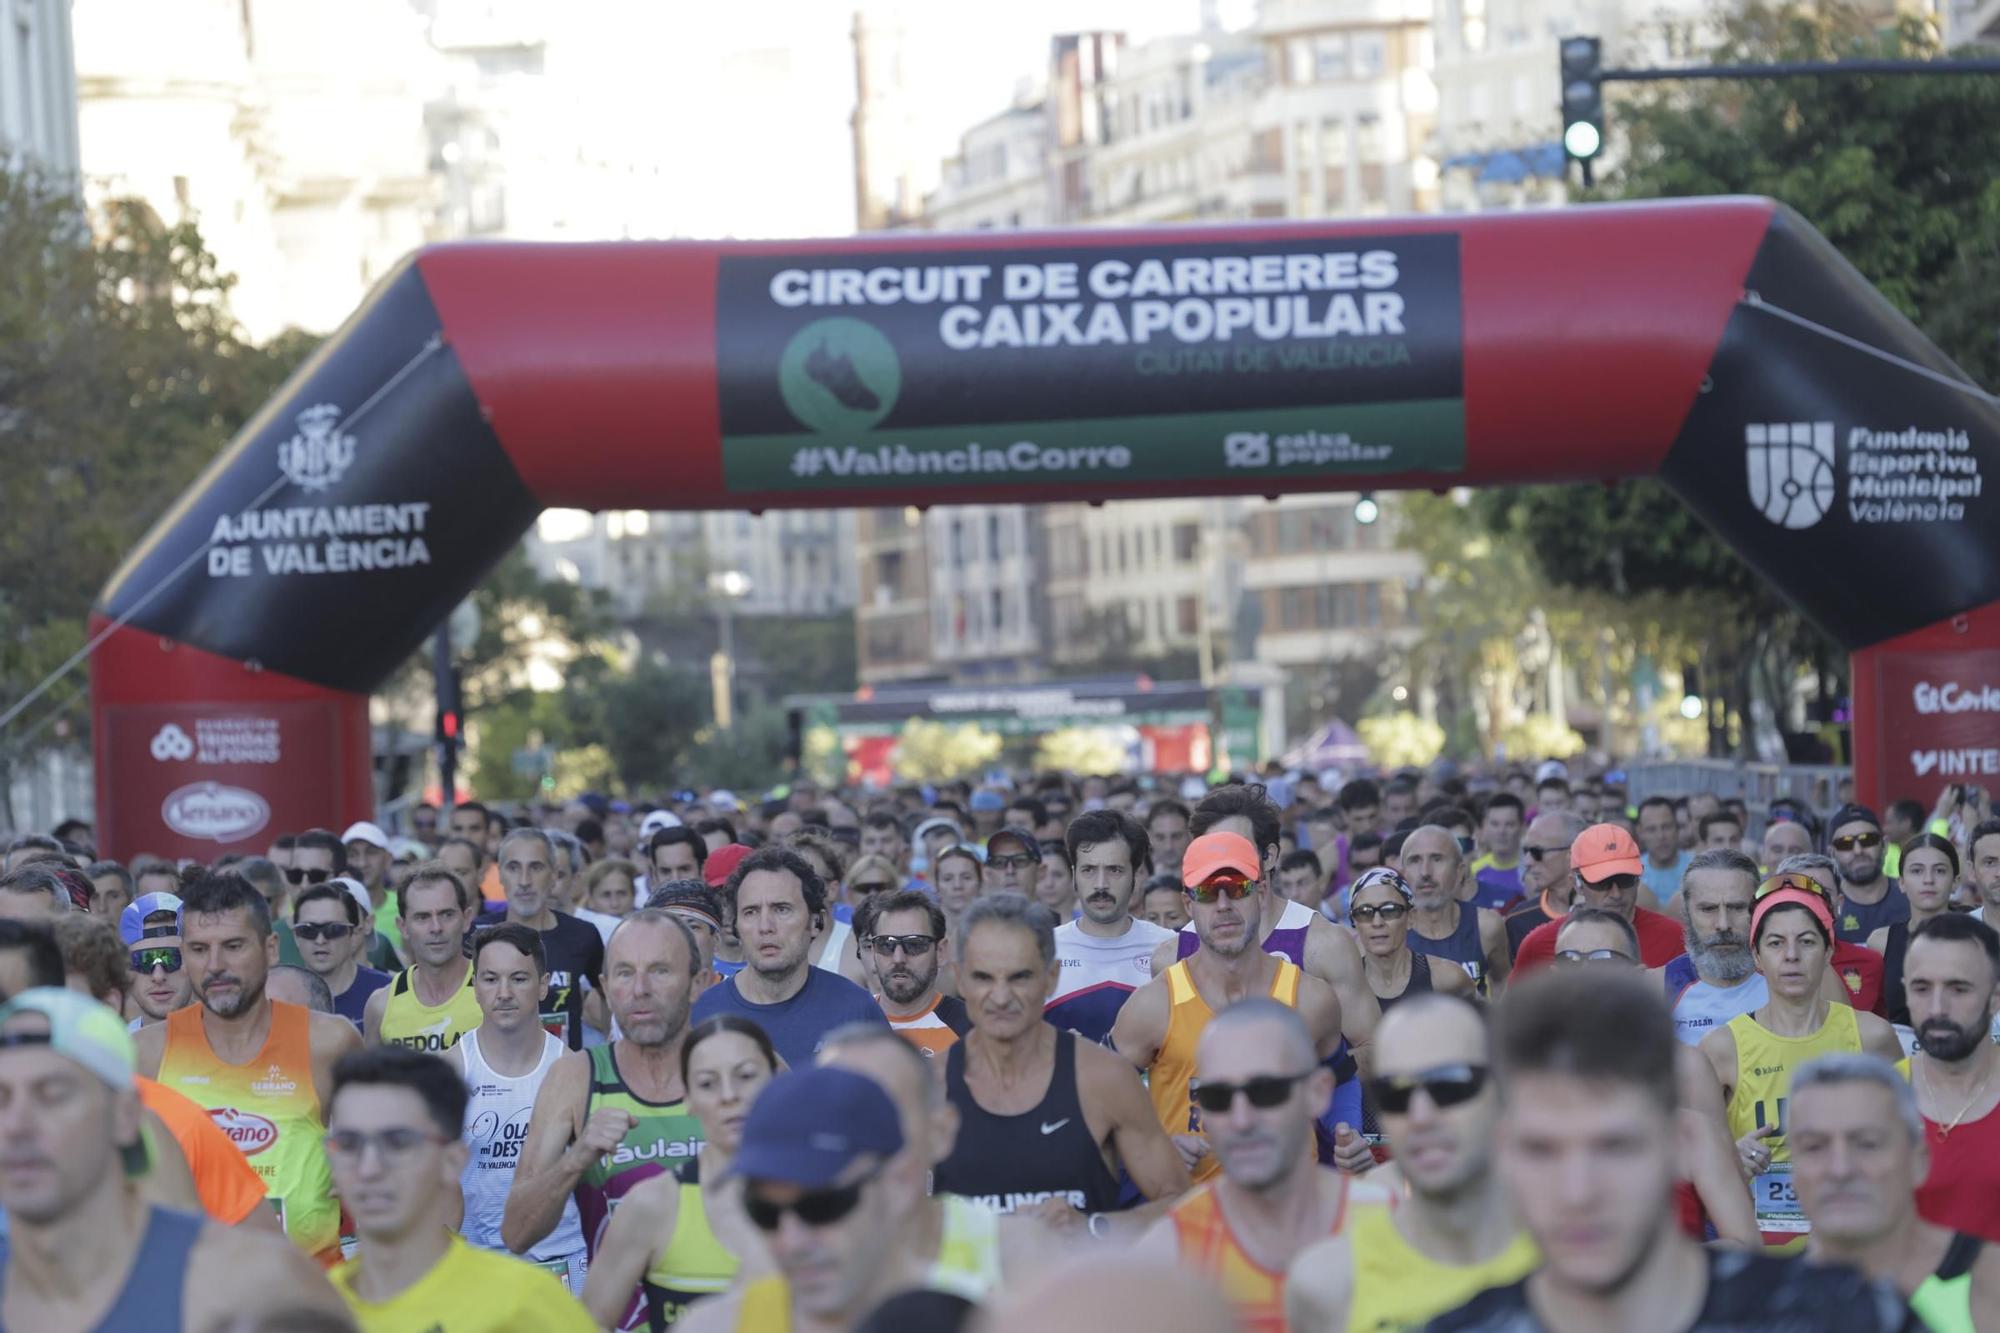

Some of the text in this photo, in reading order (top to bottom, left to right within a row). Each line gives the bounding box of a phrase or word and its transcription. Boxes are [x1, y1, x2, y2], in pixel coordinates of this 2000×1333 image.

[769, 251, 1399, 306] CIRCUIT DE CARRERES
[1135, 350, 1227, 375] CIUTAT
[1234, 348, 1272, 371] DE
[1850, 426, 1970, 451] Fundació
[1849, 473, 1983, 503] Municipal
[209, 502, 431, 543] AJUNTAMENT
[208, 537, 431, 577] DE VALÈNCIA
[223, 1126, 270, 1142] rano
[480, 1144, 491, 1154] mi
